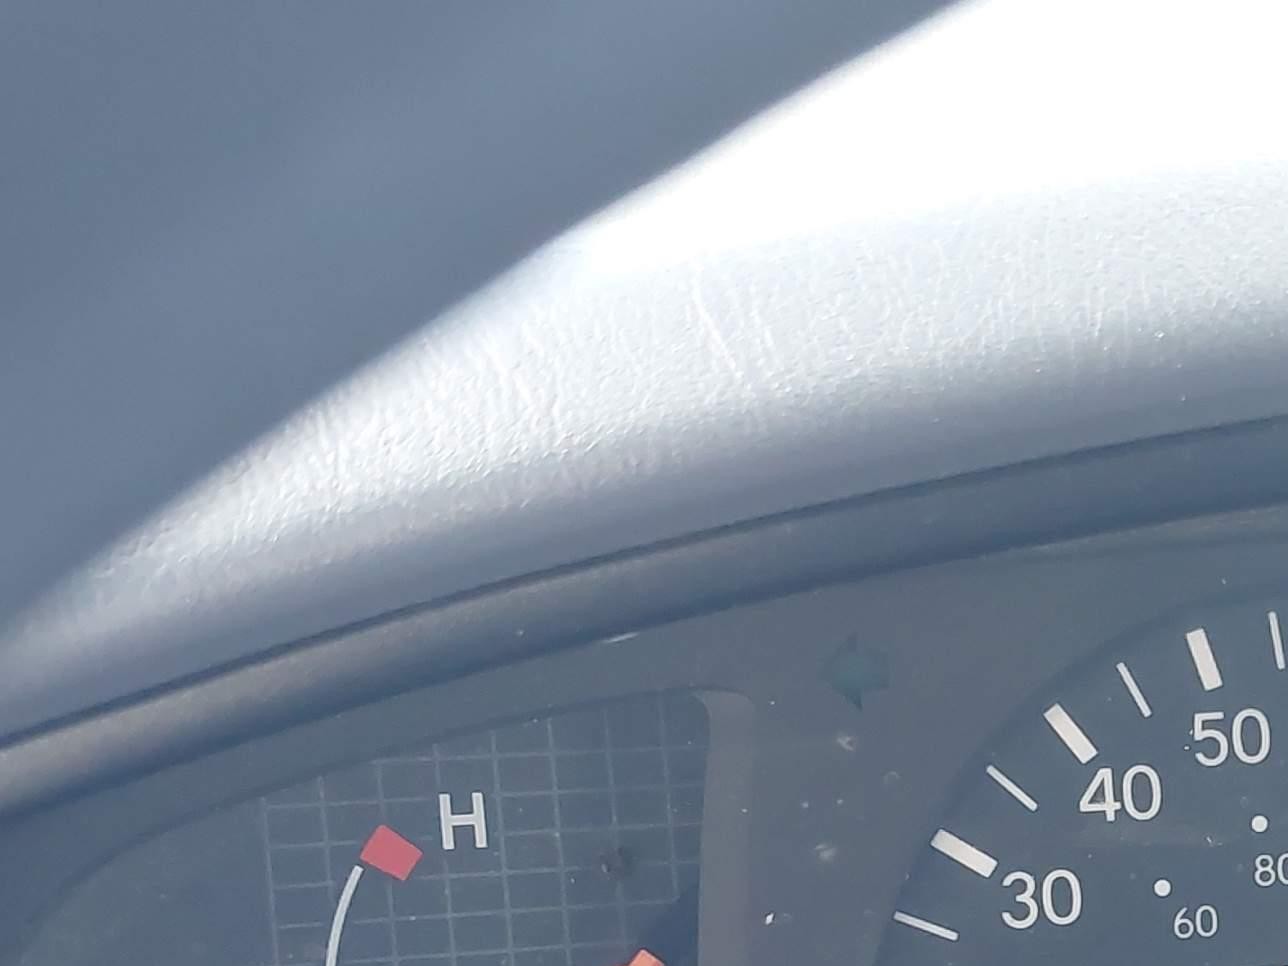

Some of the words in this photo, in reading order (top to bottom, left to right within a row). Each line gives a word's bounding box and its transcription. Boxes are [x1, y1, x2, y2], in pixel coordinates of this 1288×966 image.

[1193, 708, 1271, 767] 50
[438, 792, 488, 850] H
[1079, 764, 1163, 822] 40
[1001, 869, 1083, 929] 30
[1173, 905, 1218, 940] 60
